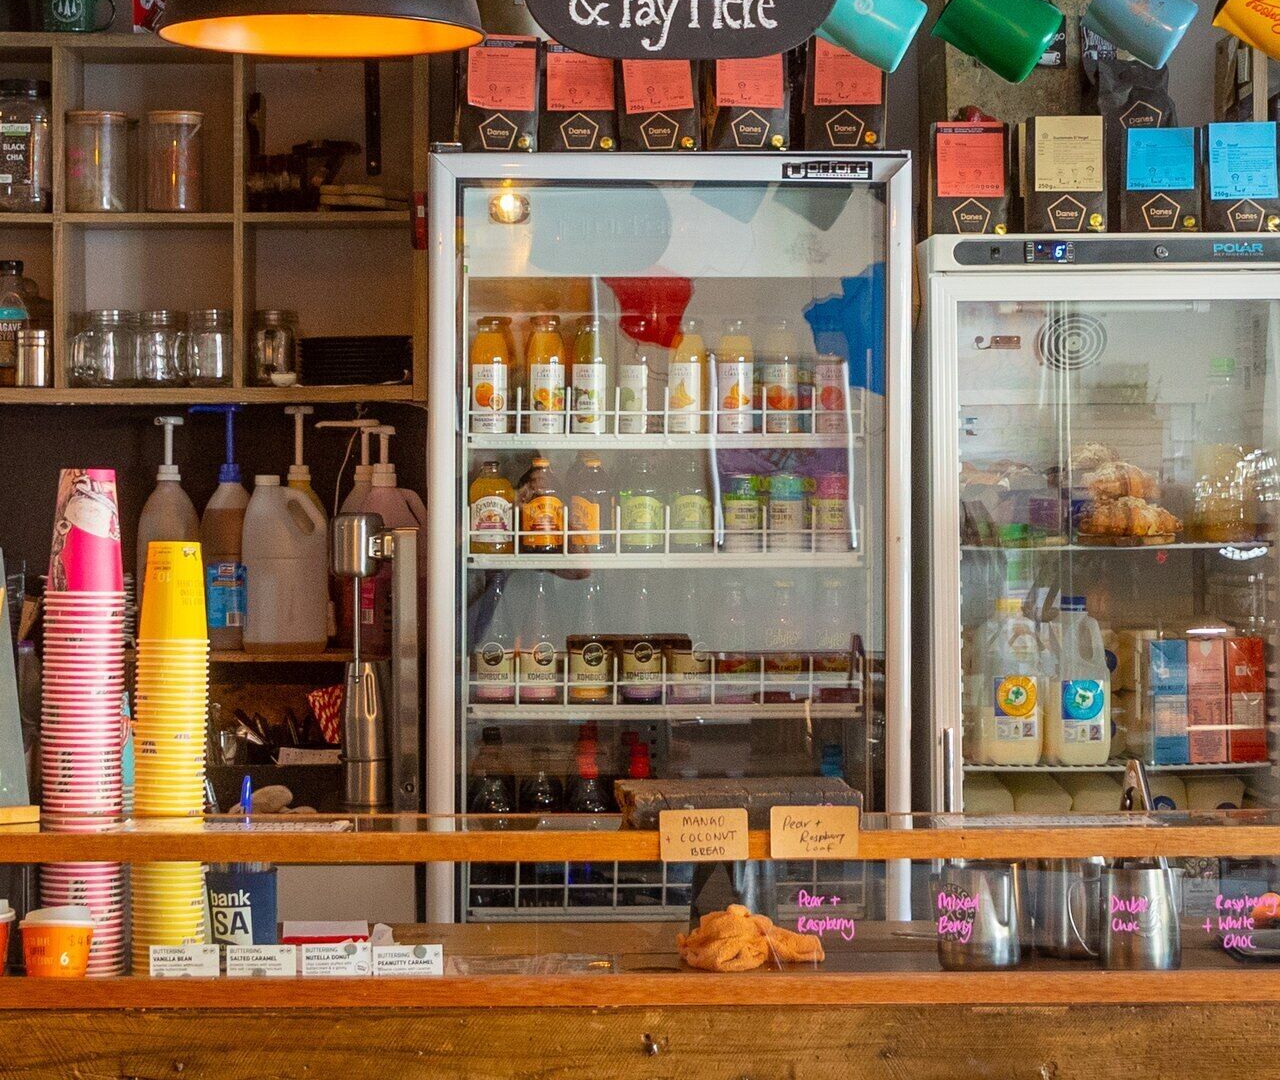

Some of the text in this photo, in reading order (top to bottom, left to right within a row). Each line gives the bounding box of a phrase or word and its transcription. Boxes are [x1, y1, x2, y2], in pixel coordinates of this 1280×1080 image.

[487, 128, 510, 137] Danes
[3, 143, 26, 151] BLACK
[6, 153, 24, 161] CHIA
[1056, 209, 1078, 218] Danes
[1214, 242, 1264, 253] POLAR
[682, 815, 726, 828] MANGO
[690, 846, 726, 857] BREAD
[210, 889, 252, 906] bank
[937, 892, 980, 912] Mixed
[214, 909, 251, 936] SA
[59, 952, 69, 966] 6
